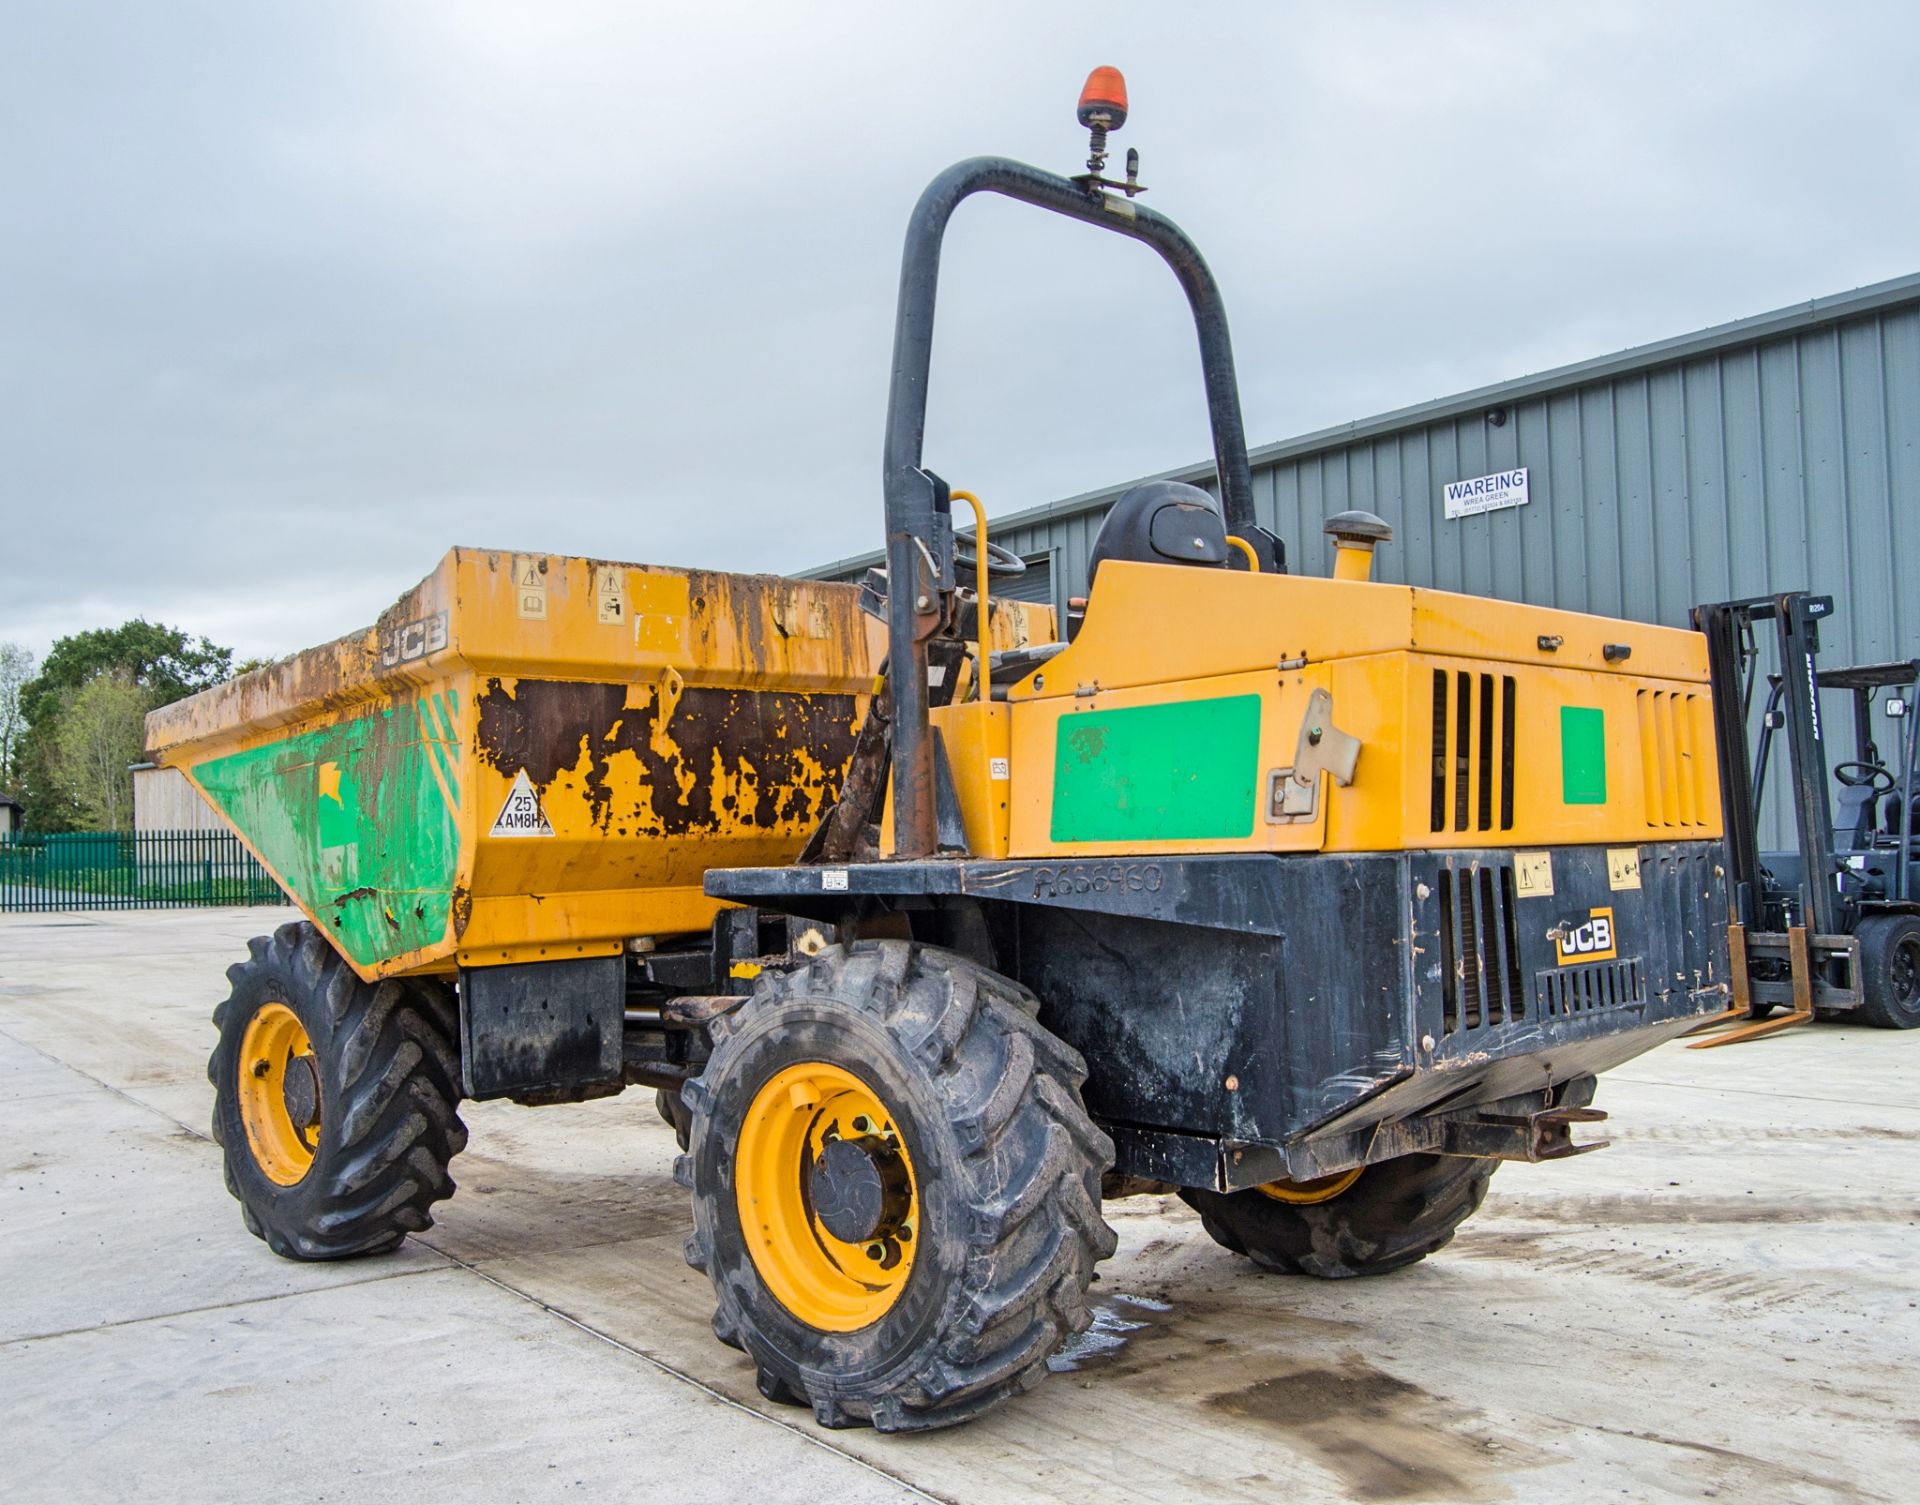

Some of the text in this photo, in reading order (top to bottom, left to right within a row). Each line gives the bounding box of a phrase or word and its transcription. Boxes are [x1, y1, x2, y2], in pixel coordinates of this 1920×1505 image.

[1448, 472, 1524, 500] WAREING
[1464, 497, 1483, 507] WREA
[1485, 491, 1509, 501] GREEN
[382, 615, 447, 666] JCB
[515, 797, 531, 811] 25
[505, 813, 540, 828] AM8H
[1561, 919, 1611, 954] JCB
